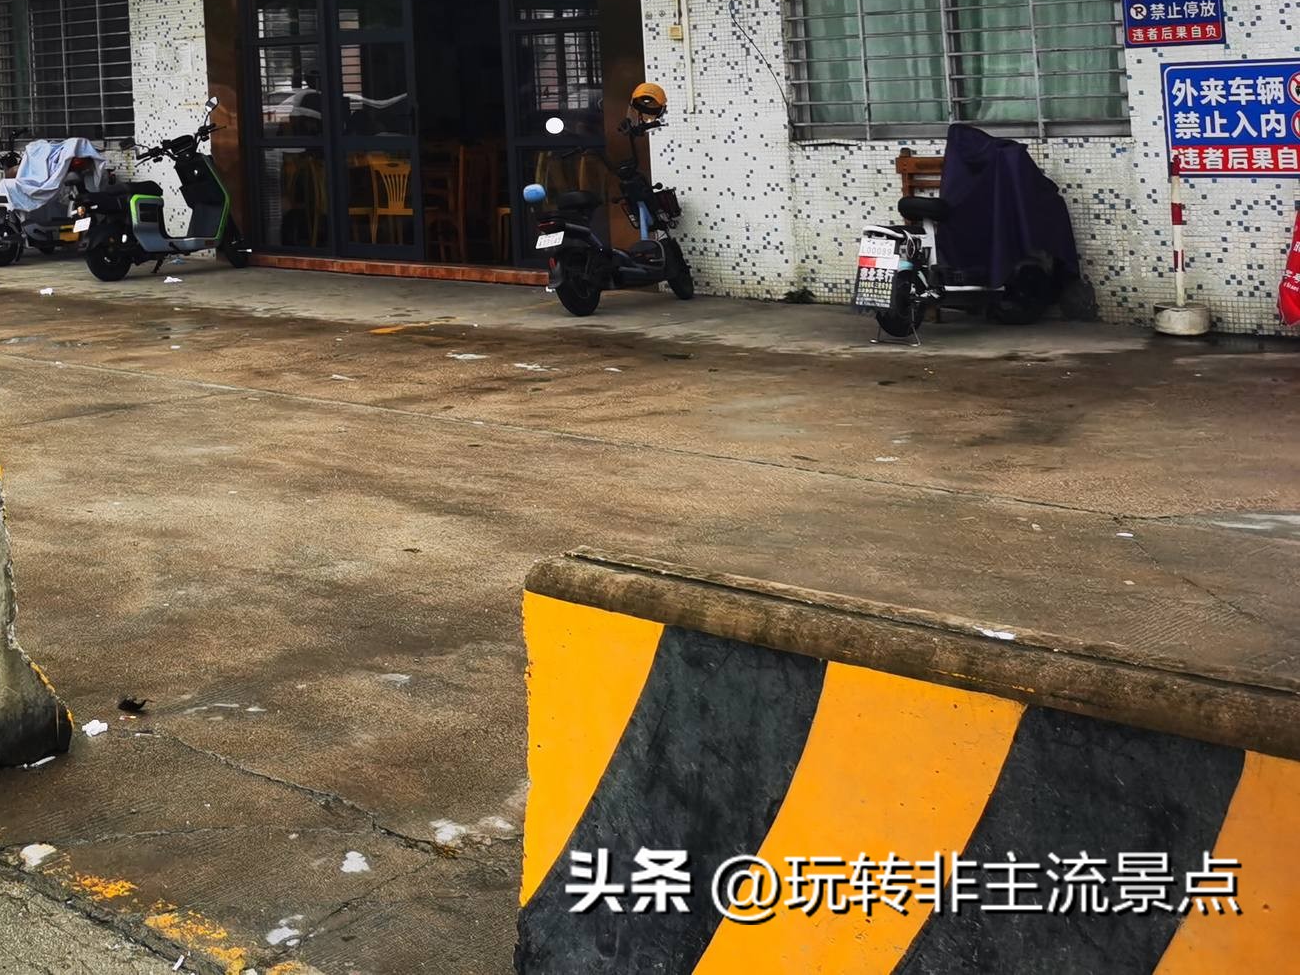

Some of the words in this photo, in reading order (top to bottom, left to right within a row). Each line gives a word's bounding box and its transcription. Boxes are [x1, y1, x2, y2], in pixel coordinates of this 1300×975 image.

[1150, 0, 1216, 20] 禁止停放
[1132, 25, 1217, 42] 违者后果自负
[1171, 76, 1285, 107] 外来车辆
[1174, 109, 1287, 140] 禁止入内
[1178, 146, 1298, 170] 违者后果自
